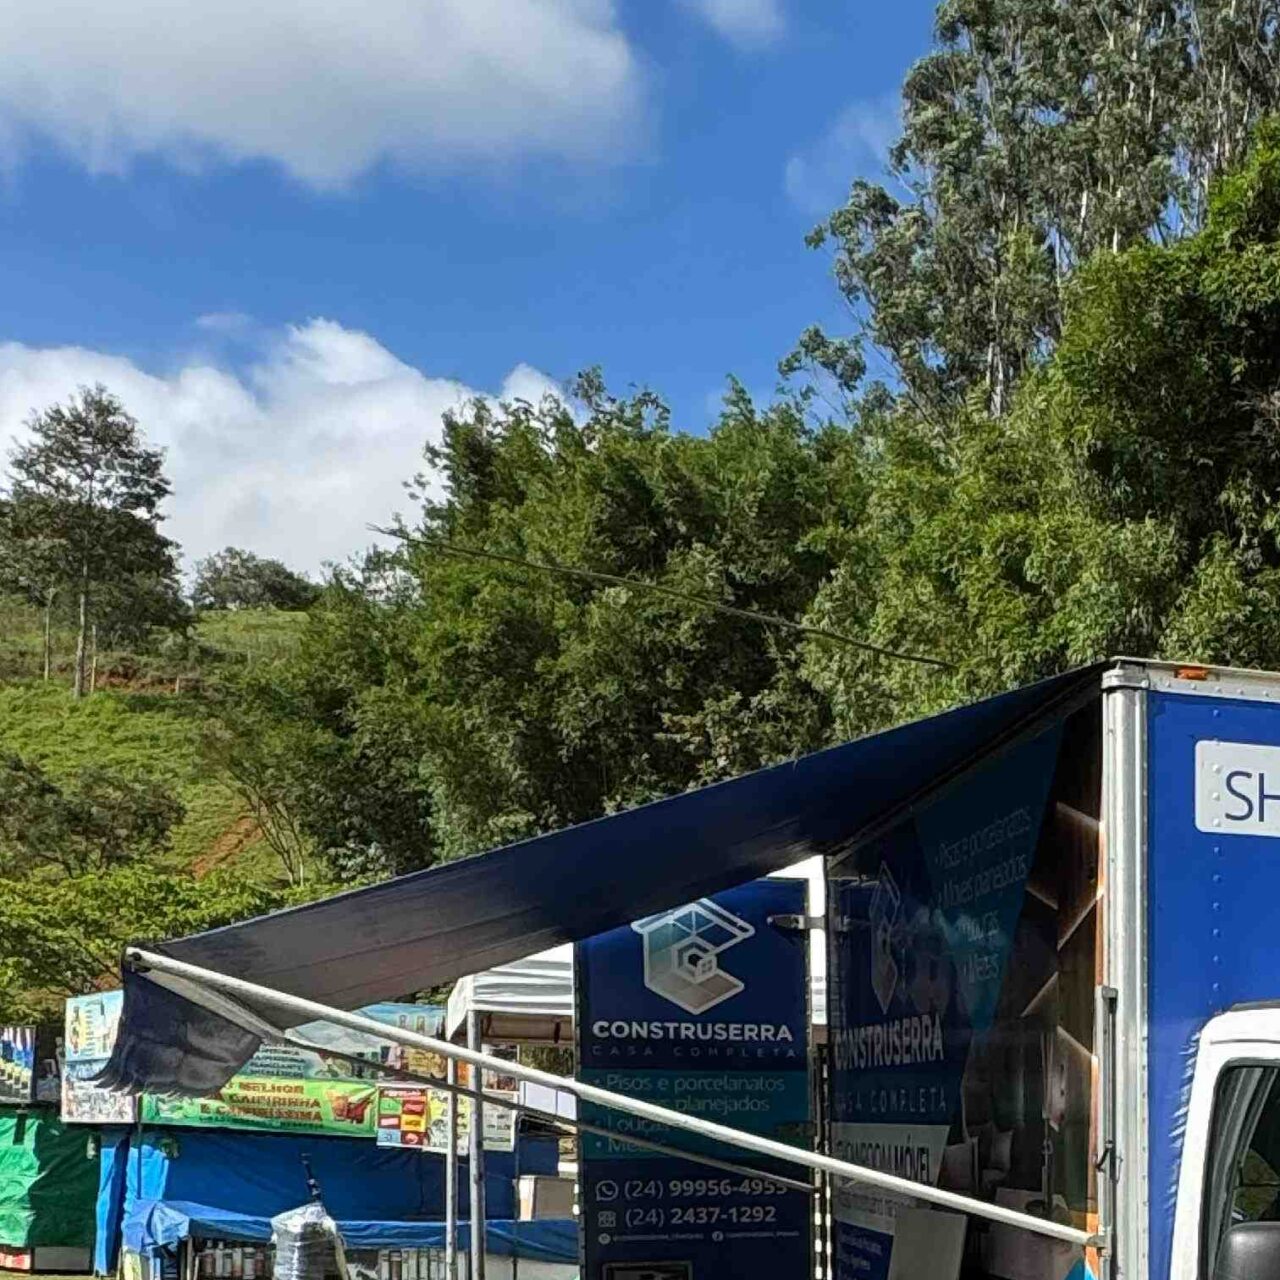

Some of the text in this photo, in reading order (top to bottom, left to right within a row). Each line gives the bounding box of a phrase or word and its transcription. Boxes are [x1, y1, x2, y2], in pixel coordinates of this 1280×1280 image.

[592, 1020, 794, 1042] CONSTRUSERRA
[592, 1045, 797, 1058] CASA COMPLETA
[606, 1074, 786, 1095] Pisos e porcelanatos
[675, 1095, 771, 1115] planejados
[624, 1180, 664, 1200] (24)
[625, 1206, 778, 1228] (24) 2437-1292
